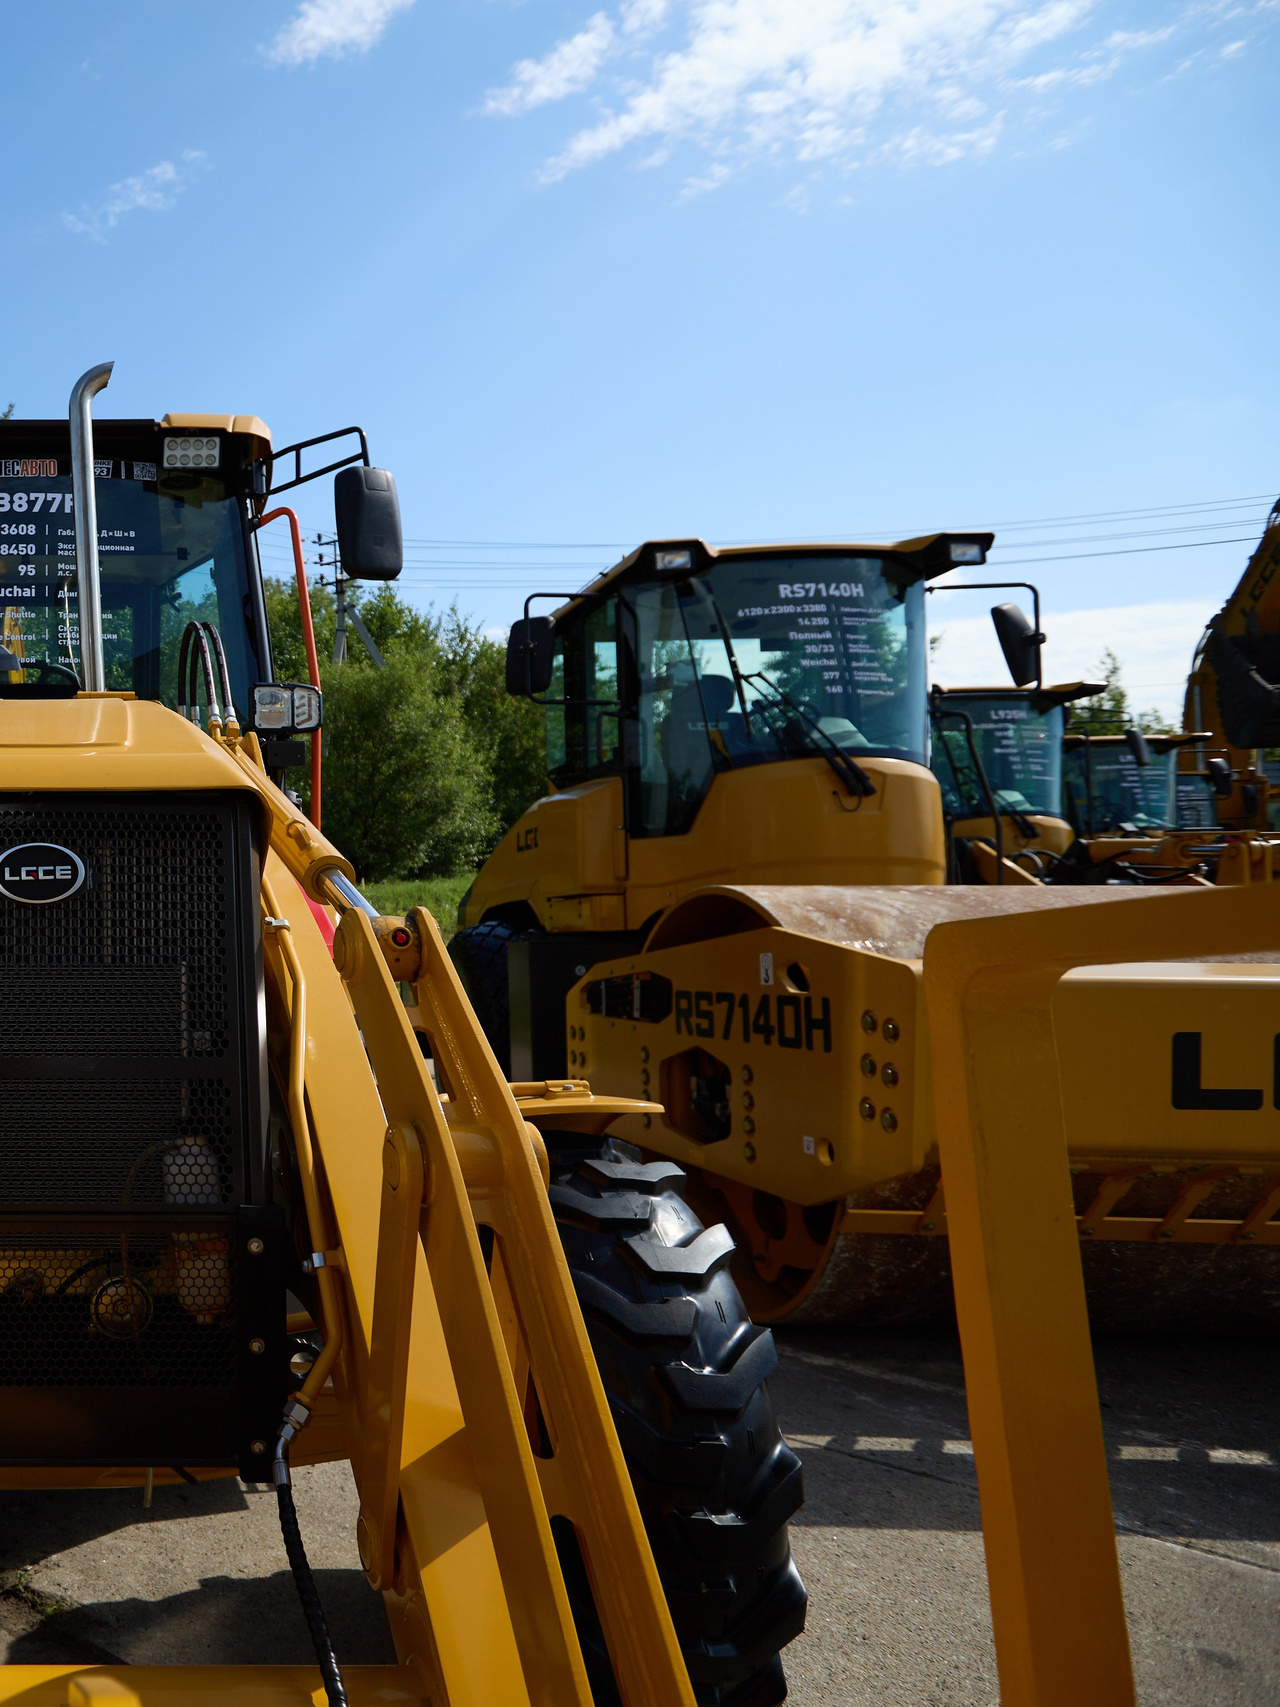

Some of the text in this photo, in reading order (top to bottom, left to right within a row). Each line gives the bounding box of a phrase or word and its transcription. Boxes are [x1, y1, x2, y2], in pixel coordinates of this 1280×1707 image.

[0, 543, 36, 556] 8450
[17, 564, 36, 576] 95
[779, 582, 865, 598] RS7140H
[5, 611, 36, 619] Shuttle
[5, 632, 36, 640] Control
[789, 631, 832, 640] Полный
[805, 644, 835, 653] 30/33
[801, 658, 838, 667] Weichai
[823, 672, 840, 680] 377
[825, 685, 843, 693] 160
[4, 865, 72, 881] LGCE
[675, 989, 832, 1053] RS7140H
